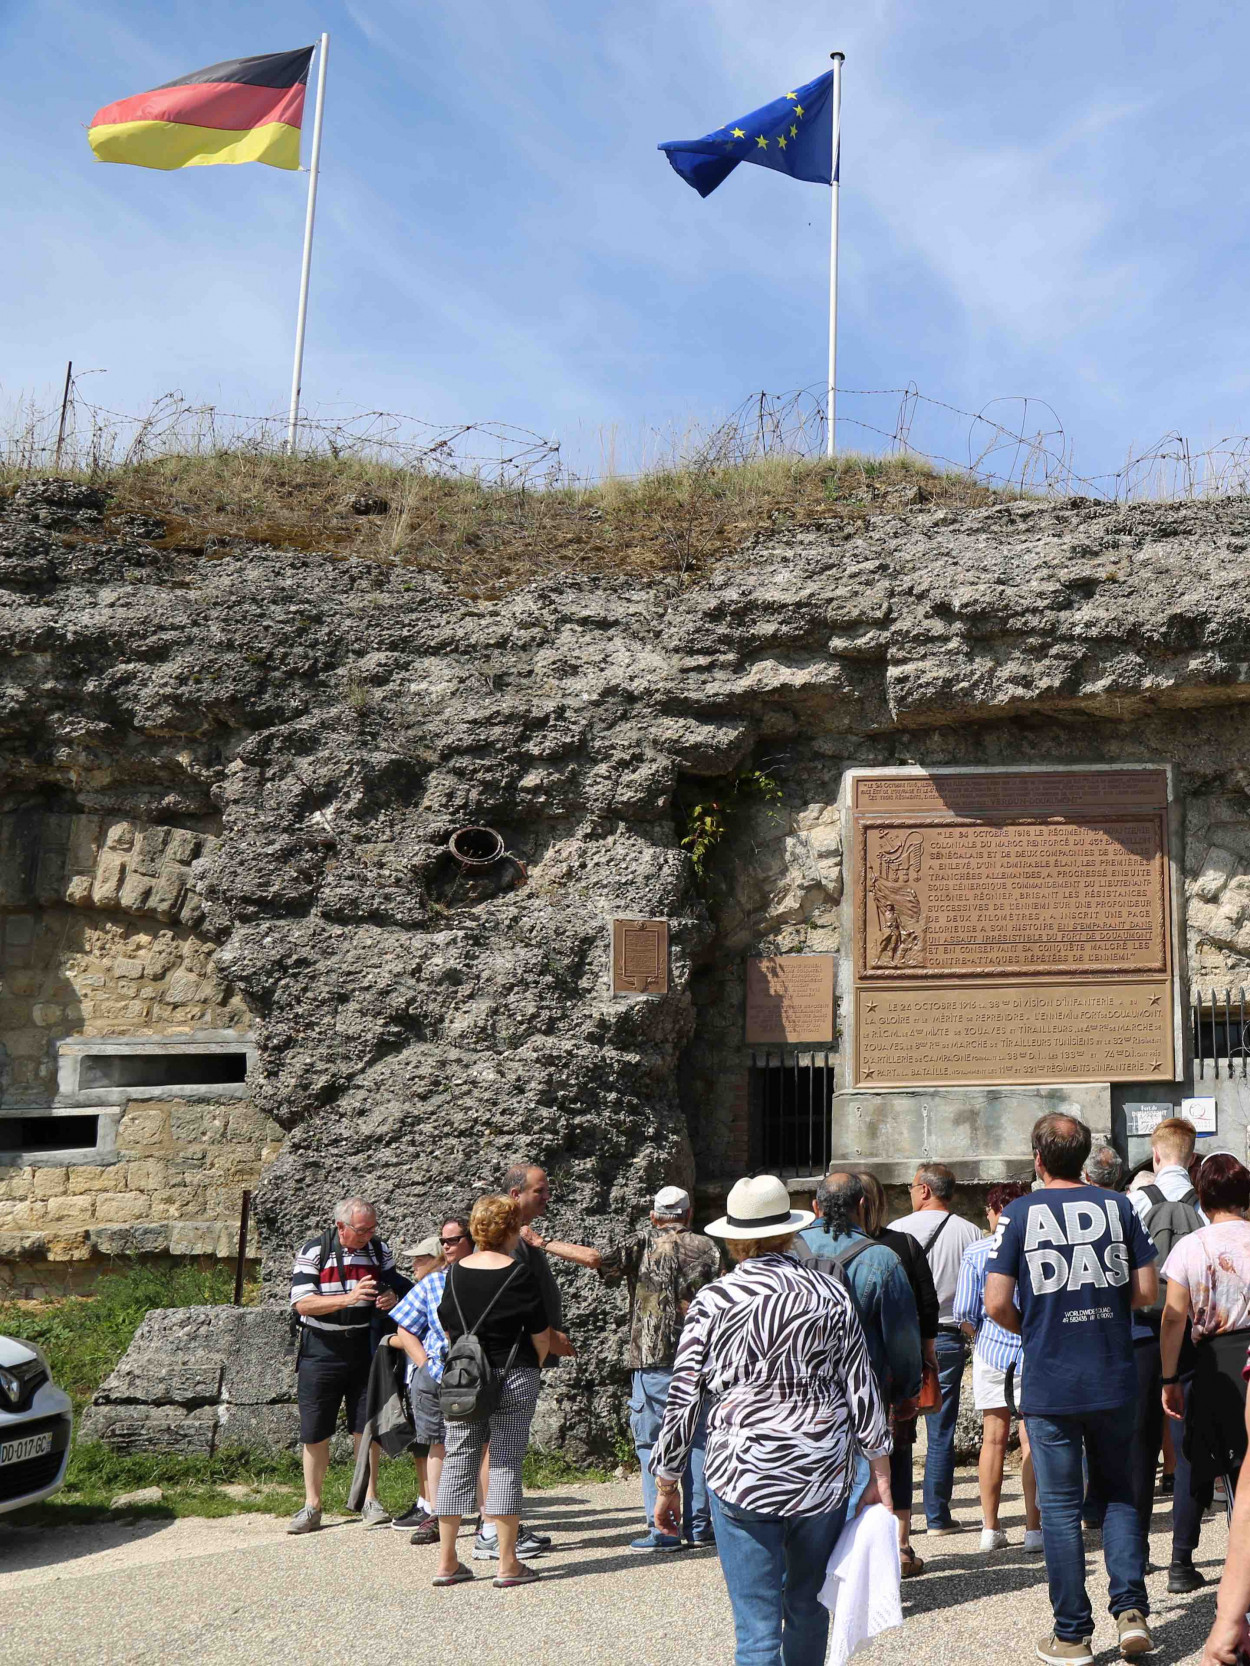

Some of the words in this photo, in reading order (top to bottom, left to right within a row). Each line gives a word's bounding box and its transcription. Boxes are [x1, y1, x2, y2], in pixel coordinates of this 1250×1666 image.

[1048, 828, 1089, 836] RÉGIMENT
[1026, 838, 1069, 847] RENFORCÉ
[930, 851, 984, 860] SÉNÉGALAIS
[1038, 849, 1095, 857] COMPAGNIES
[929, 872, 982, 881] TRANCHÉES
[986, 871, 1045, 879] ALLEMANDES,
[1057, 869, 1107, 877] PROGRESSÉ
[1011, 881, 1080, 889] COMMANDEMENT
[1085, 890, 1147, 898] RÉSISTANCES
[928, 904, 989, 912] SUCCESSIVES
[1096, 900, 1151, 908] PROFONDEUR
[1072, 921, 1126, 929] S'EMPARANT
[960, 945, 1018, 953] CONSERVANT
[1039, 942, 1085, 952] CONQUÊTE
[1090, 941, 1128, 950] MALGRÉ
[929, 956, 1020, 965] CONTRE-ATTAQUES
[1024, 953, 1068, 963] RÉPÉTÉES
[888, 1003, 898, 1011] LE
[915, 1002, 957, 1011] OCTOBRE
[1013, 998, 1052, 1008] DIVISION
[1056, 996, 1114, 1007] D'INFANTERIE
[879, 1015, 910, 1024] GLOIRE
[976, 1012, 1024, 1022] REPRENDRE
[964, 1027, 1006, 1035] ZOUAVES
[951, 1040, 987, 1049] MARCHE
[1001, 1038, 1051, 1048] TIRAILLEURS
[1054, 1036, 1094, 1046] TUNISIENS
[864, 1054, 913, 1064] D'ARTILLERIE
[923, 1054, 971, 1062] CAMPAGNE
[1024, 1200, 1123, 1251] ADI
[1025, 1242, 1130, 1296] DAS
[1064, 1309, 1095, 1317] WORLDWIDE
[2, 1435, 46, 1463] DD-017-GC
